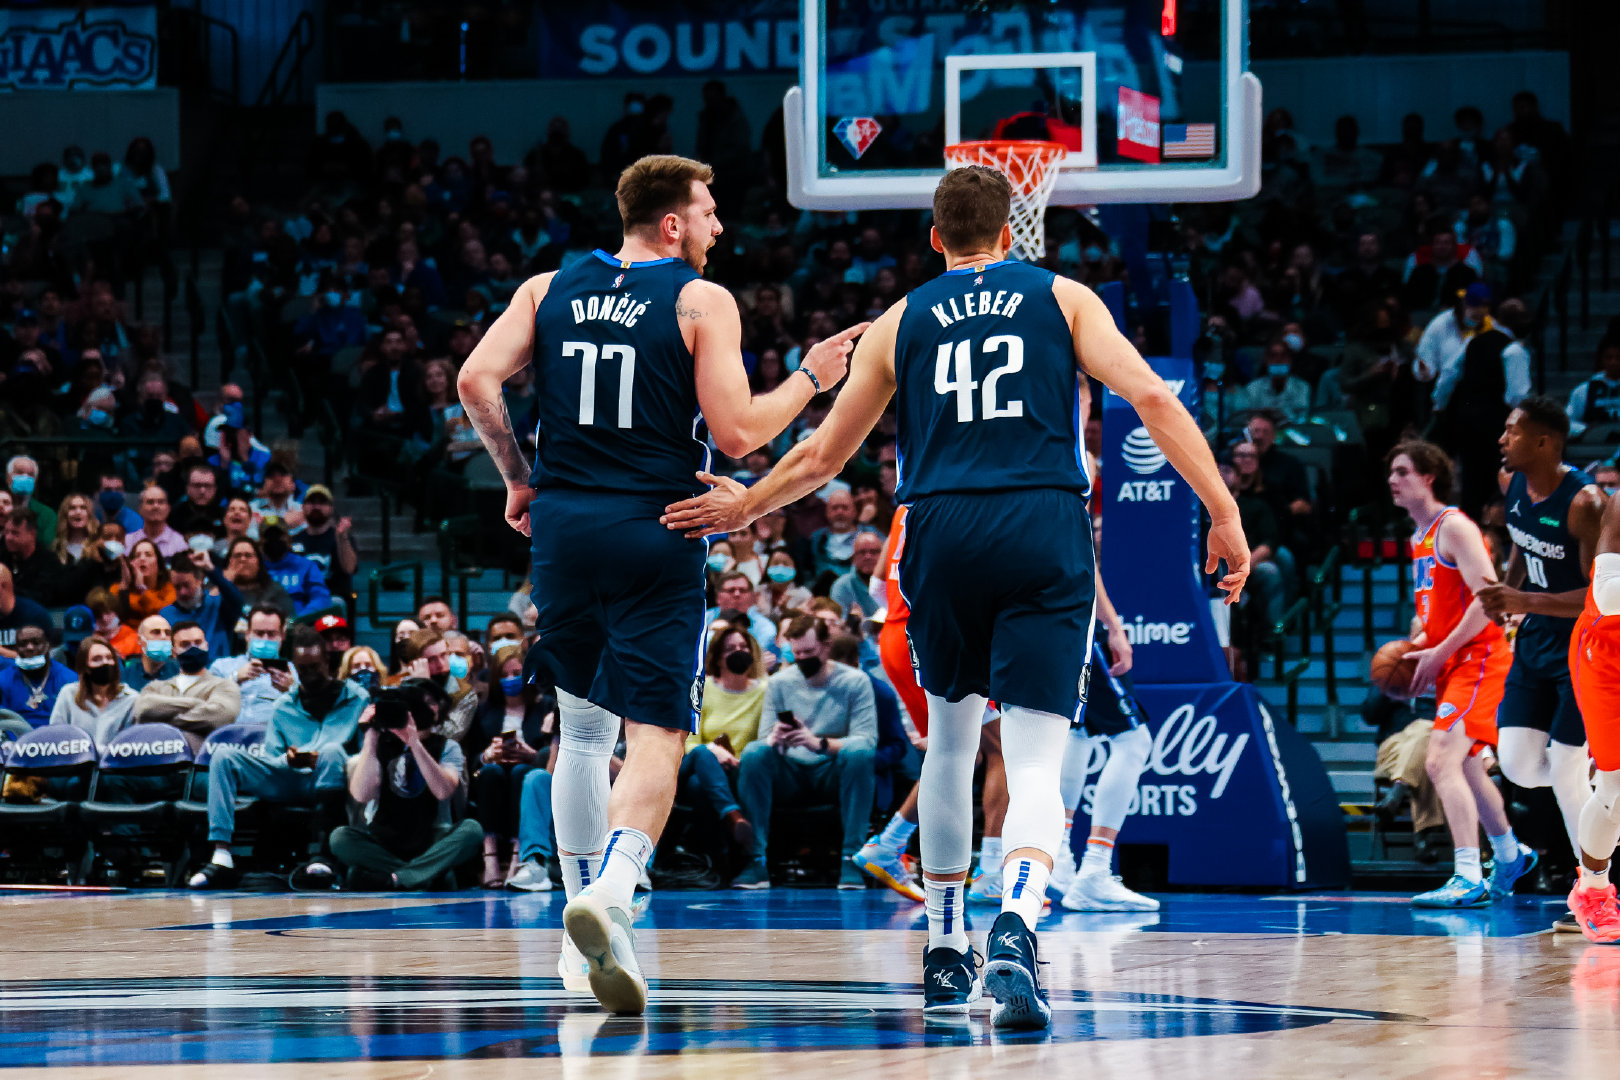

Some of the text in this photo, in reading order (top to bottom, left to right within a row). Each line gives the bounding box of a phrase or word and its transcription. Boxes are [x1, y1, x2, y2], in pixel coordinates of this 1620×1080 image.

[571, 292, 652, 328] DONČIĆ
[931, 290, 1024, 328] KLEBER
[561, 341, 636, 429] 77
[934, 334, 1024, 423] 42
[1117, 480, 1176, 502] AT&T
[1523, 552, 1549, 589] 10
[1103, 615, 1191, 645] hime
[15, 739, 91, 758] VOYAGER
[108, 739, 185, 758] VOYAGER
